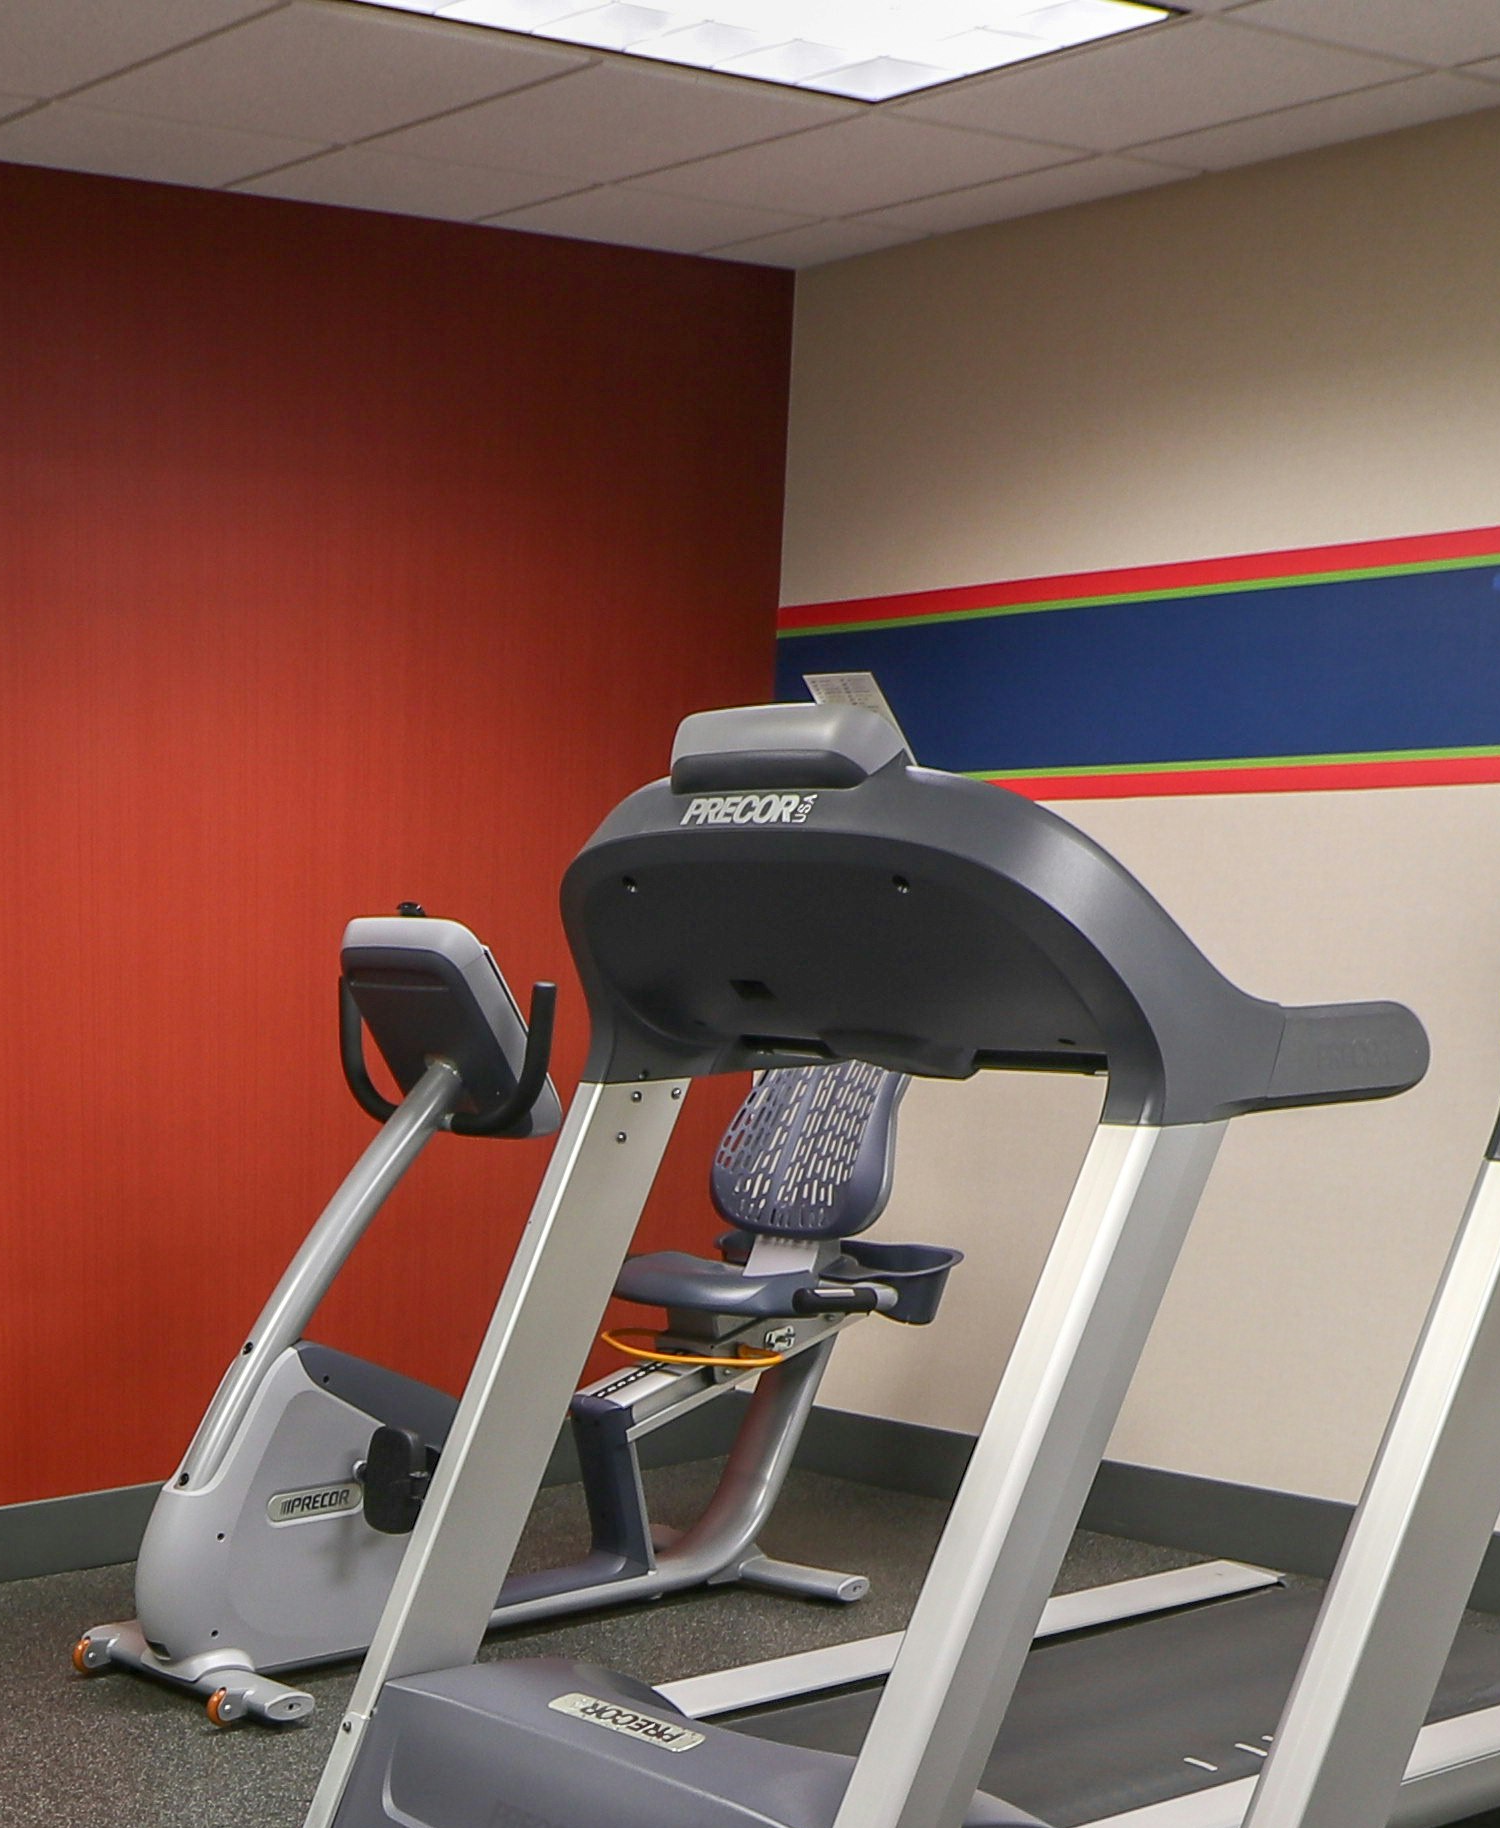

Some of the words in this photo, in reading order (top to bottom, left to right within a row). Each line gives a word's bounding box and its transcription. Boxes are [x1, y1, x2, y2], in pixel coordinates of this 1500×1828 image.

[679, 794, 801, 826] PRECOR
[791, 793, 818, 823] USA
[289, 1489, 350, 1514] PRECOR
[579, 1702, 686, 1744] PRECOR
